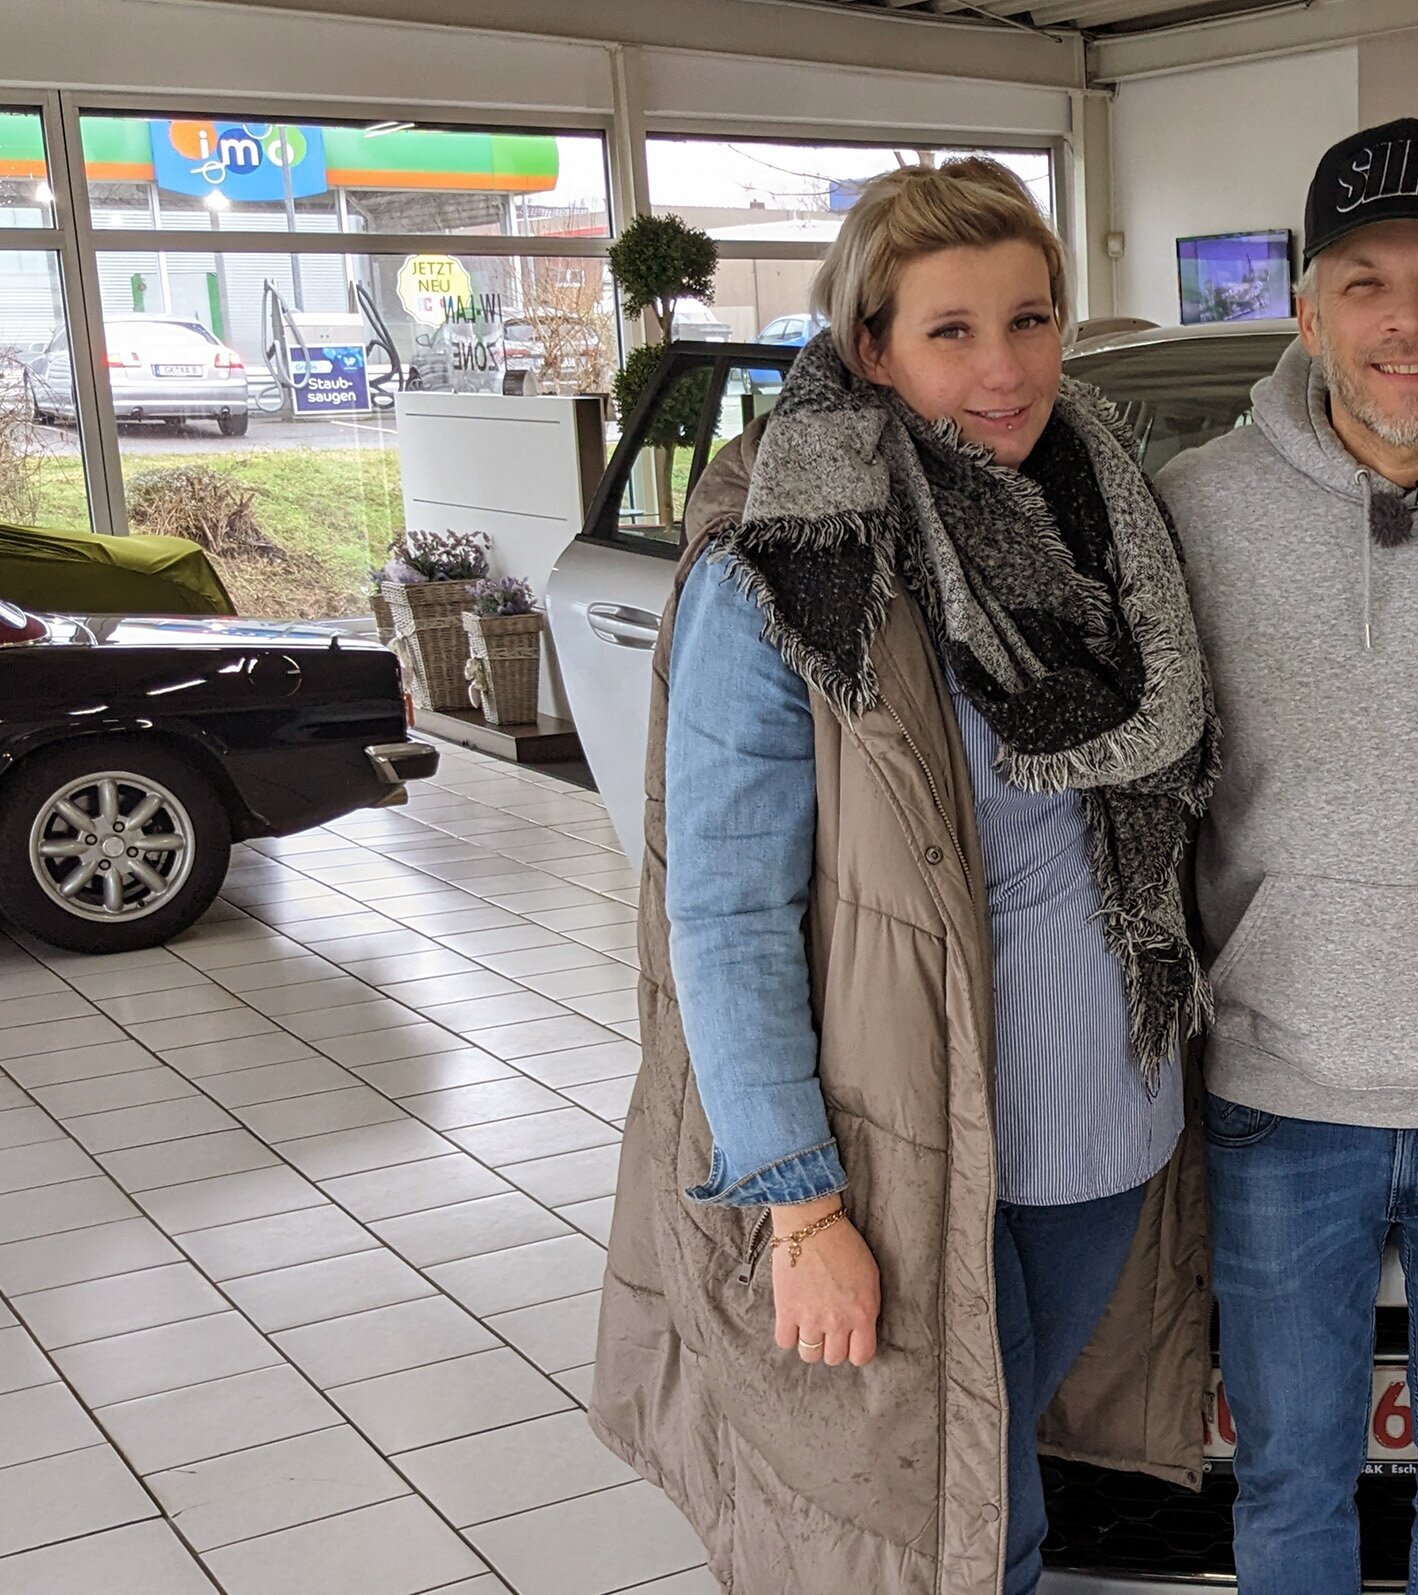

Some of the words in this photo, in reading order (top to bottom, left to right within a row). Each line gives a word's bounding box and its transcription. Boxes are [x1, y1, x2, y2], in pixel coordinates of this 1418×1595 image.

[412, 262, 454, 275] JETZT
[418, 280, 450, 293] NEU
[308, 377, 353, 390] Staub-
[307, 391, 357, 405] saugen
[1361, 1464, 1384, 1474] &K
[1391, 1464, 1417, 1474] Esch
